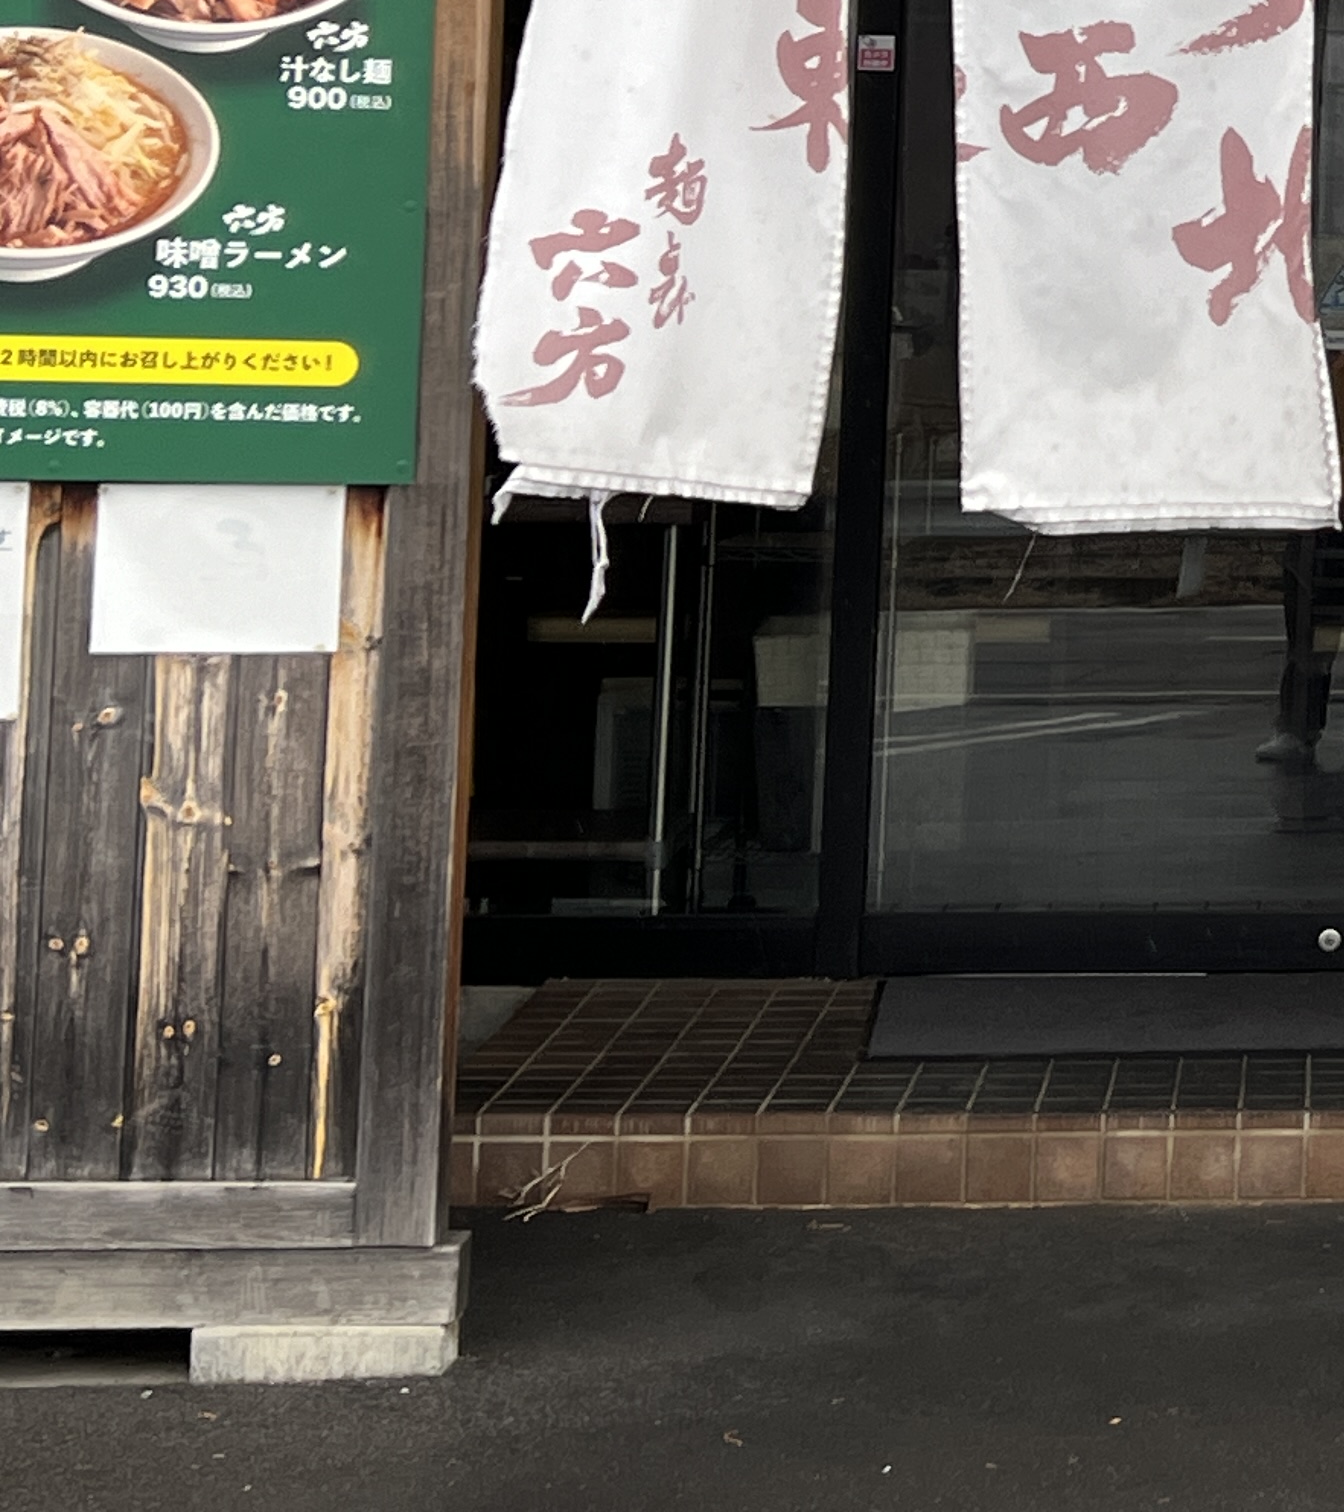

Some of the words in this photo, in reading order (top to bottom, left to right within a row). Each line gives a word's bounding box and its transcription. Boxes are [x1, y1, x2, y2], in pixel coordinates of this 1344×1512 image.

[306, 21, 370, 52] 六方
[279, 55, 393, 85] 汁なし麺
[222, 204, 286, 236] 六方
[154, 237, 348, 270] 味噌ラーメン
[499, 209, 642, 407] 六方
